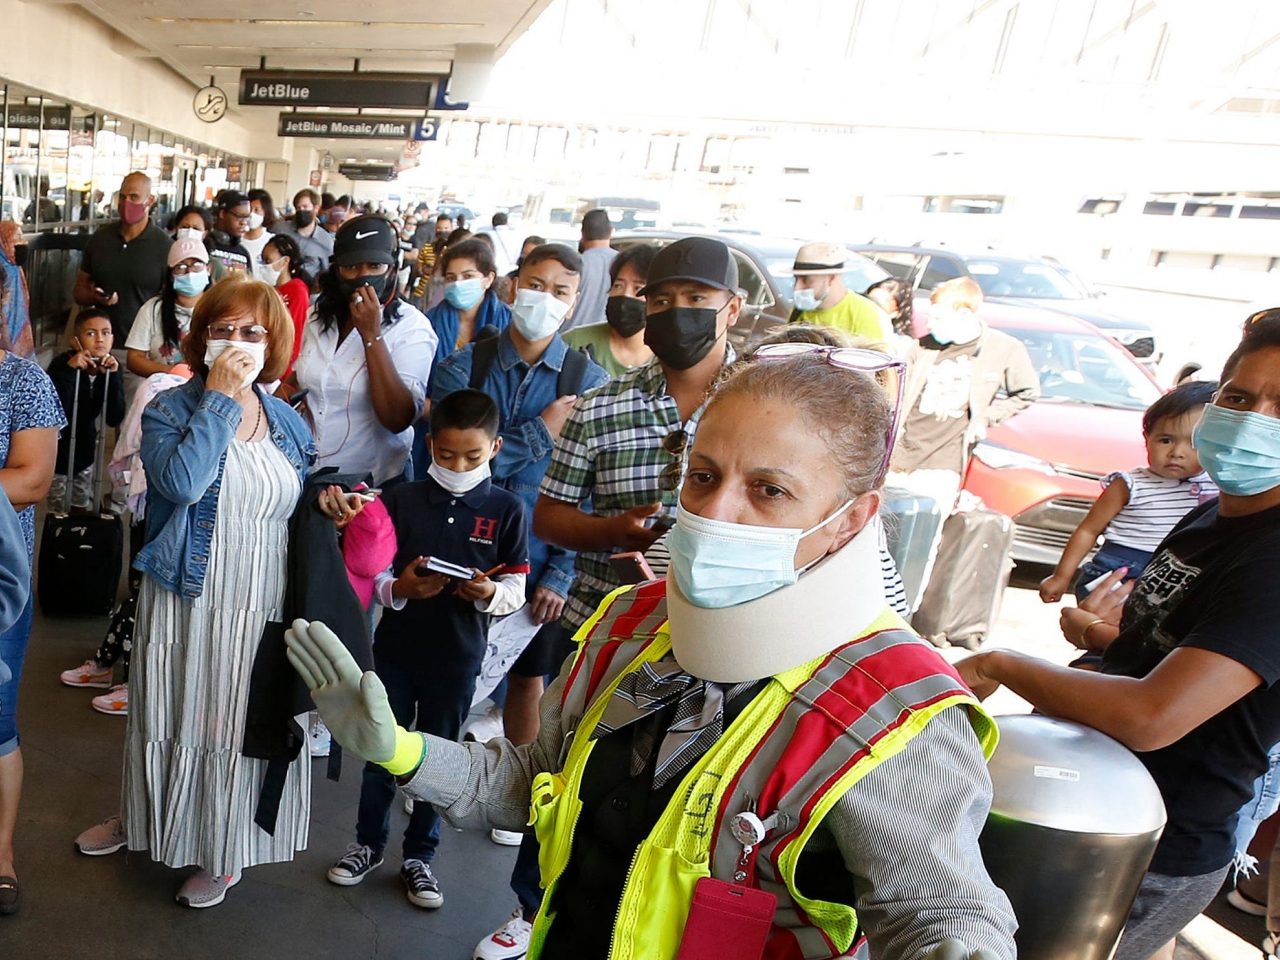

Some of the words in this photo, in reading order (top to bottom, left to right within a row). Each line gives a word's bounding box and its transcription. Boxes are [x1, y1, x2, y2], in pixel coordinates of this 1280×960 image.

[250, 82, 310, 99] JetBlue
[285, 120, 327, 132] JetBlue
[330, 121, 405, 135] Mosaic/Mint
[420, 117, 435, 138] 5
[471, 516, 497, 540] H
